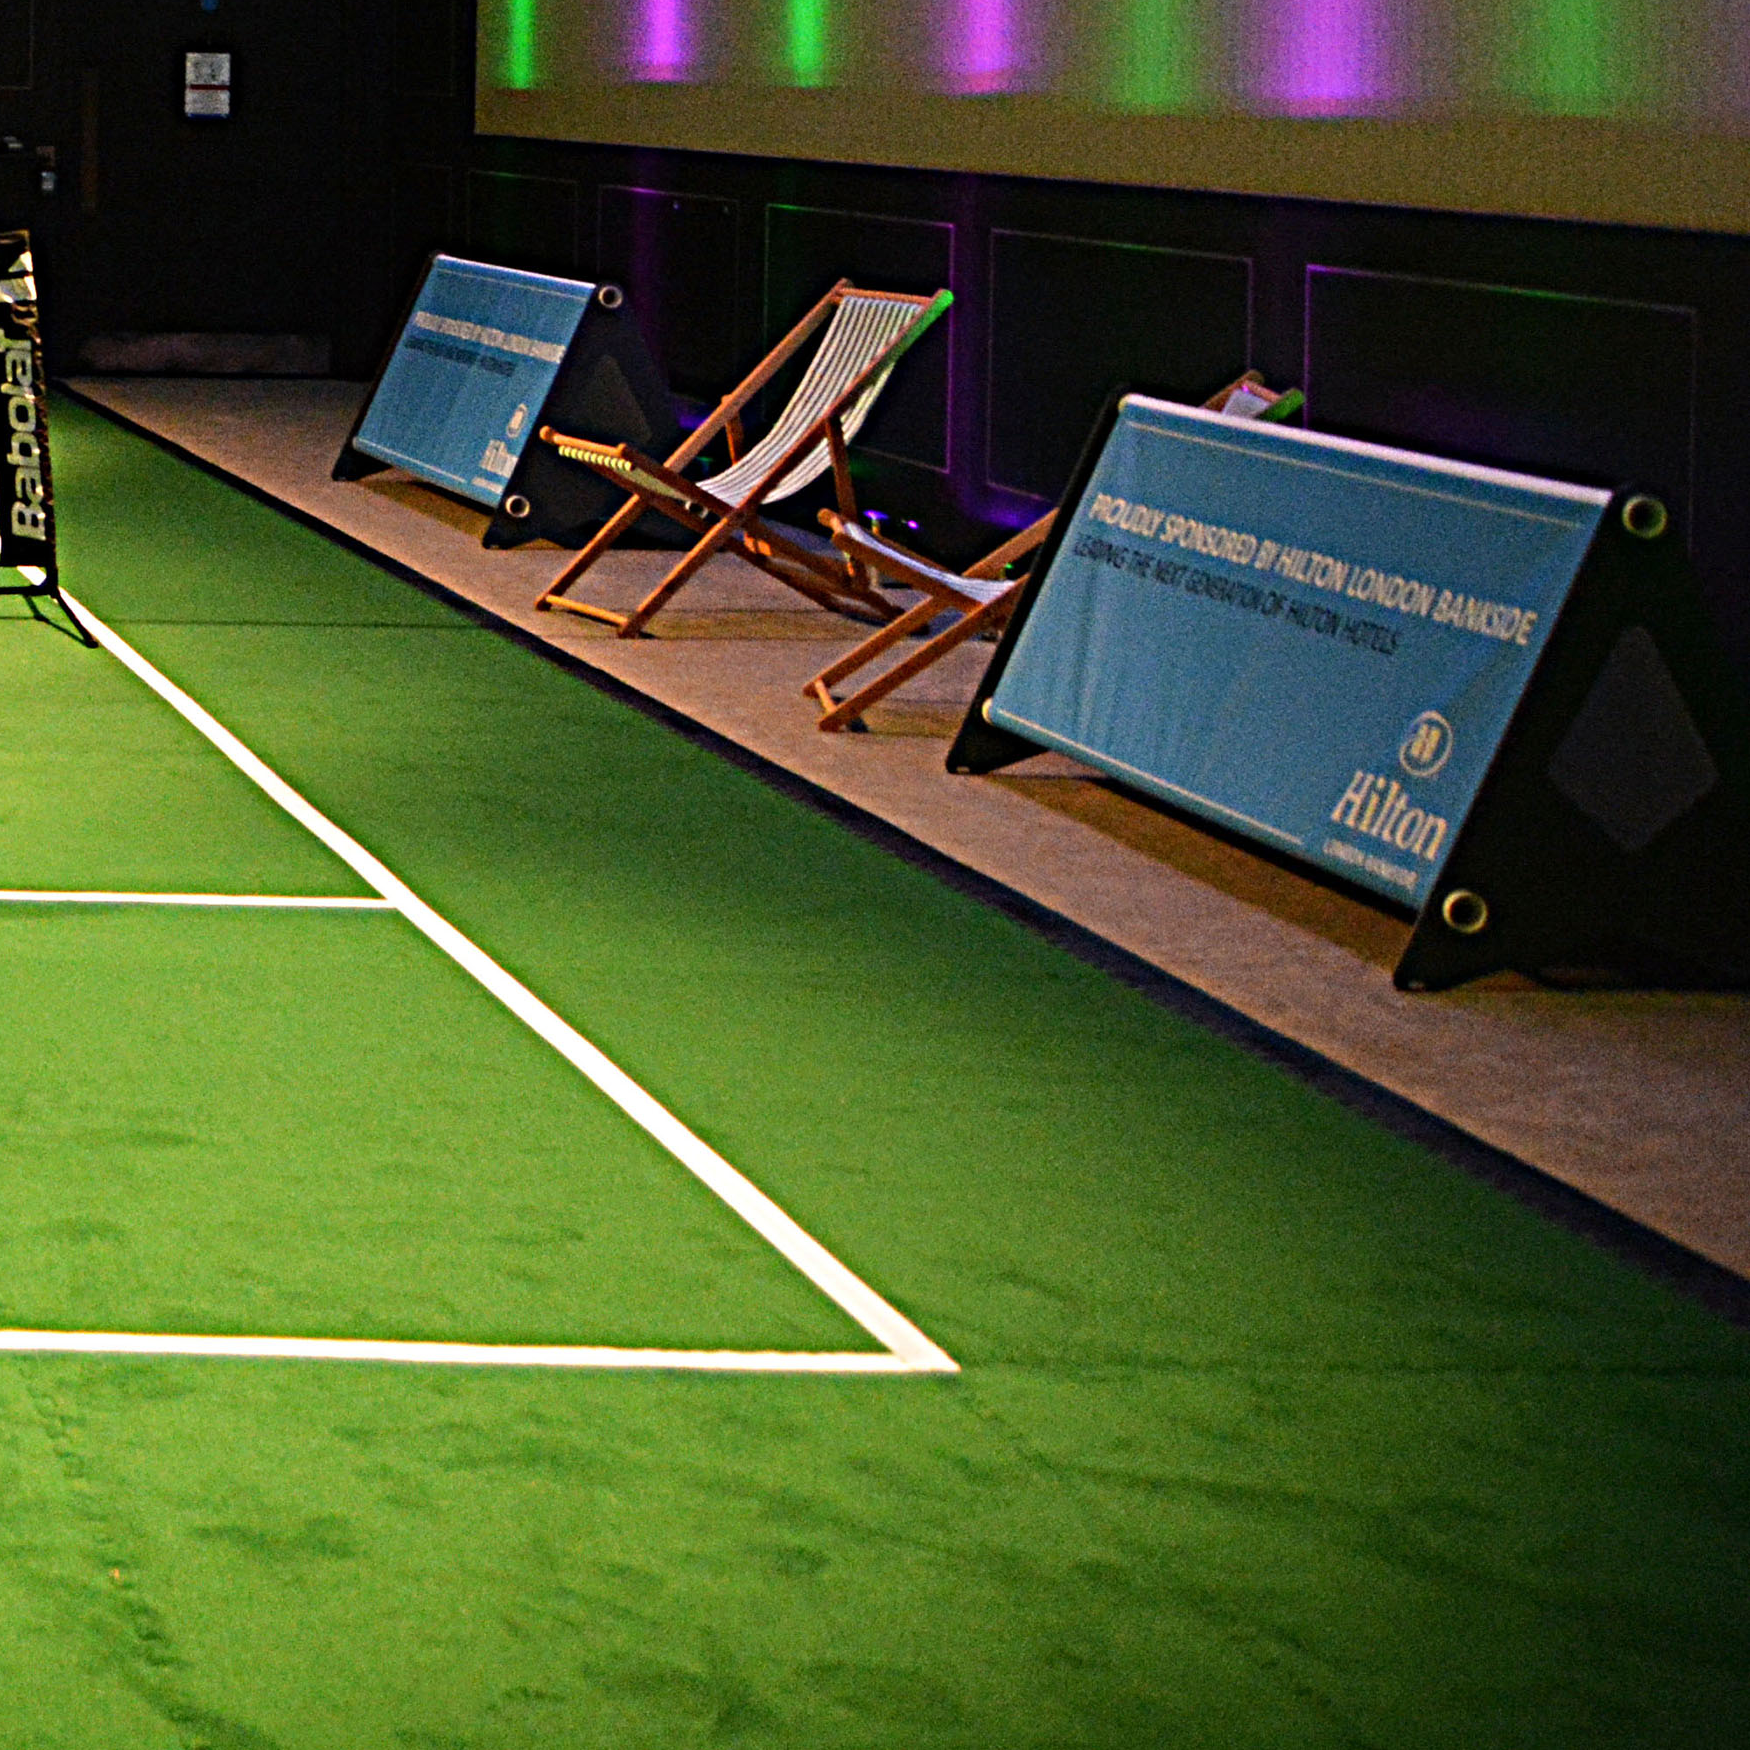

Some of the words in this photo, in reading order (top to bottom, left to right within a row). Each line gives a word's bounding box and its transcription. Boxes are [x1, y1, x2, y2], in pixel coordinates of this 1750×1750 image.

[1088, 493, 1167, 538] PROUDLY
[1159, 514, 1259, 566] SPONSORED
[1253, 538, 1283, 572] BY
[1274, 546, 1349, 593] HILTON
[1346, 566, 1438, 618] LONDON
[1432, 588, 1540, 647] BANKSIDE
[1330, 769, 1449, 862] Hilton
